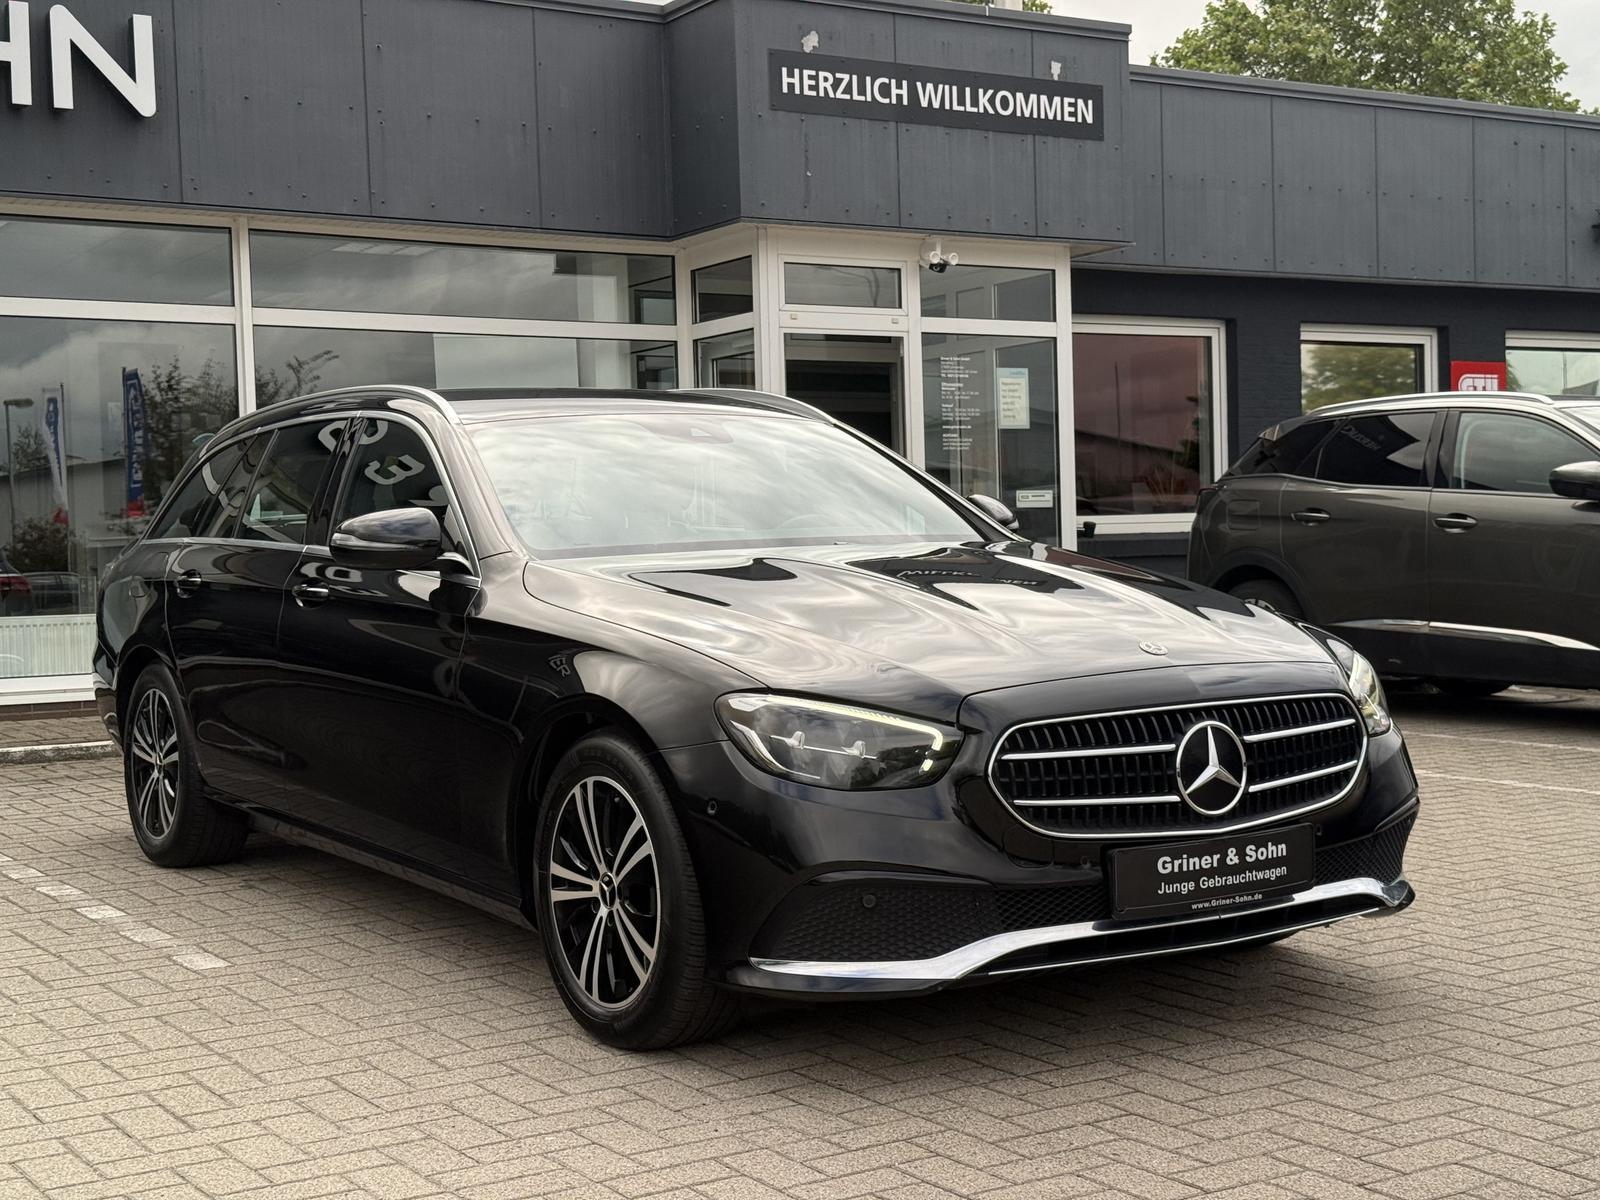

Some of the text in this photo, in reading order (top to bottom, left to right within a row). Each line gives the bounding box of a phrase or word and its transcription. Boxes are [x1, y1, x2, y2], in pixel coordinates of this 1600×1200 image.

[781, 66, 1094, 125] HERZLICH WILLKOMMEN
[1157, 841, 1287, 875] Griner & Sohn
[1157, 866, 1287, 895] Junge Gebrauchtwagen
[1191, 893, 1263, 910] www.Griner-Sohn.de
